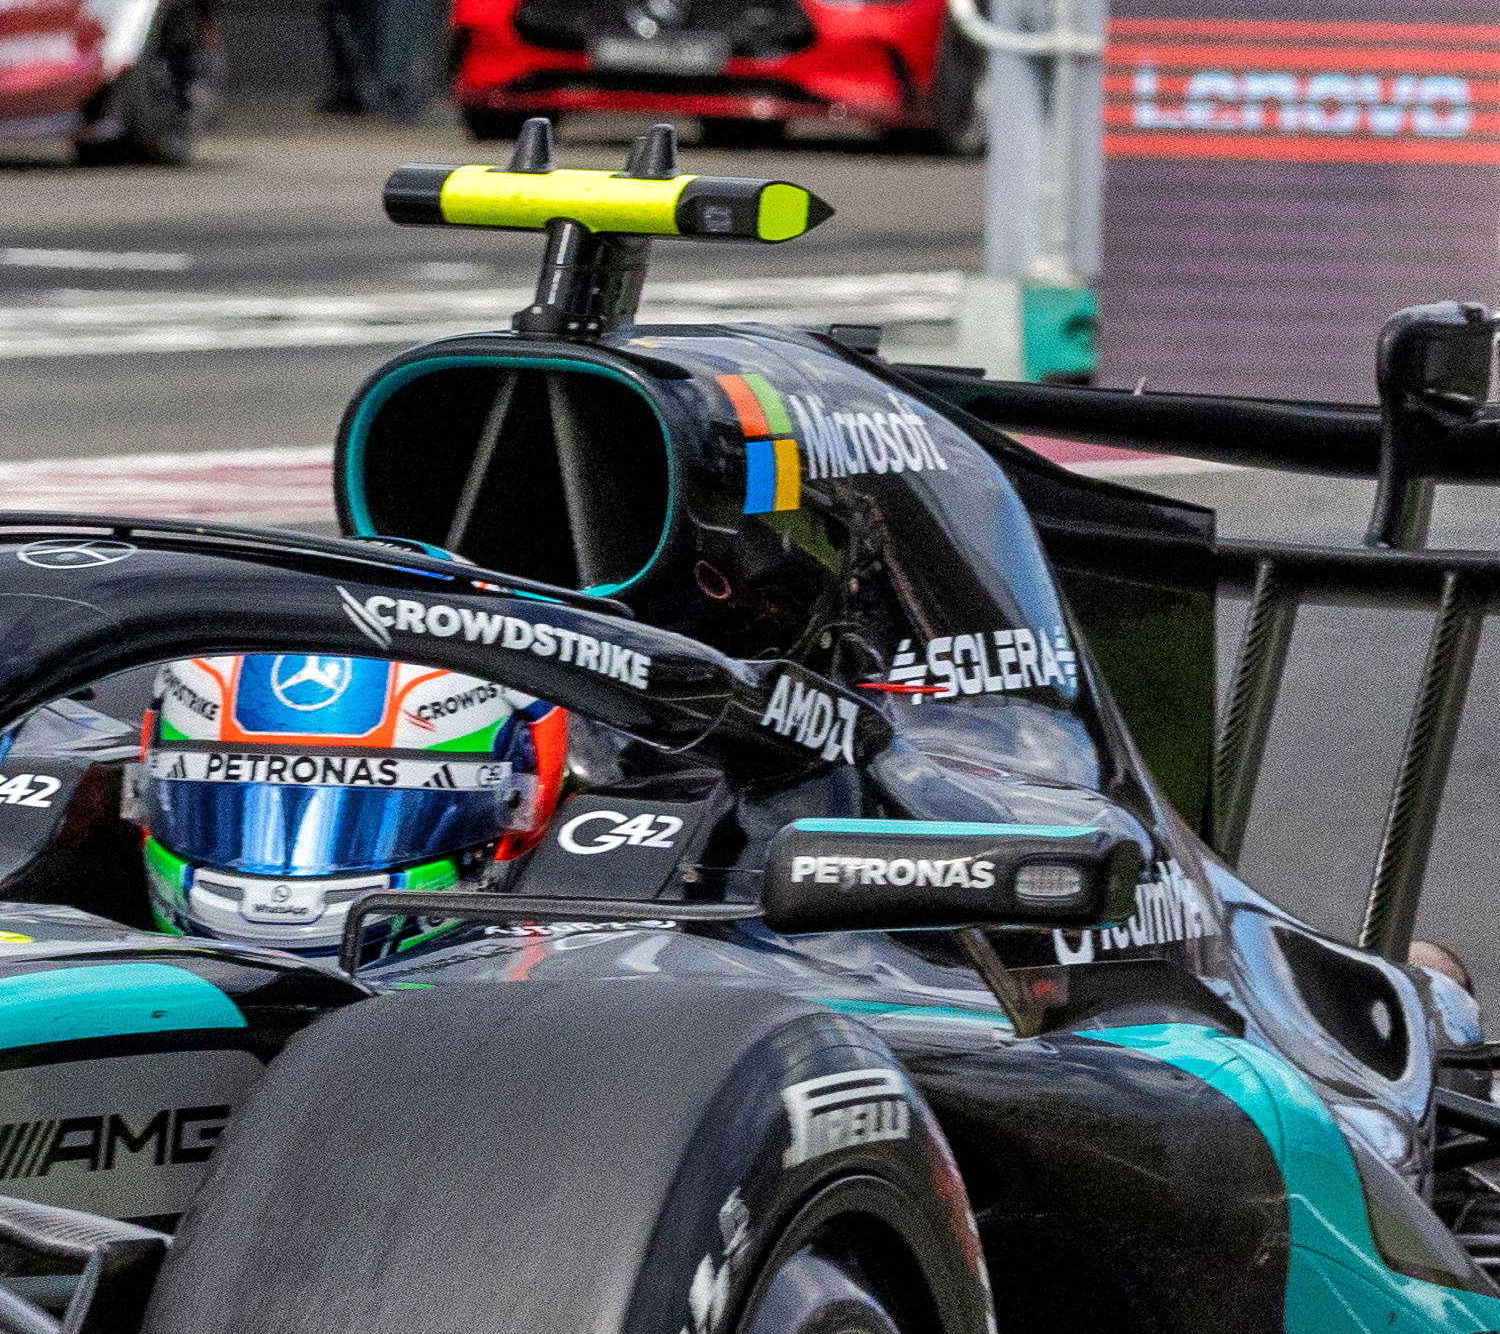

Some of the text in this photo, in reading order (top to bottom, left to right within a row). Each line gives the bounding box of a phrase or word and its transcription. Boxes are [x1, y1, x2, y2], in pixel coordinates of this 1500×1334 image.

[1133, 60, 1471, 137] Lenovo
[788, 393, 948, 479] Microsoft
[365, 595, 651, 690] CROWDSTRIKE
[927, 627, 1066, 698] SOLERA
[418, 681, 504, 722] CROWDS
[761, 674, 838, 754] AMD
[206, 754, 398, 786] PETRONAS
[557, 810, 684, 855] G42
[791, 855, 996, 889] PETRONAS
[48, 1104, 231, 1172] AMG
